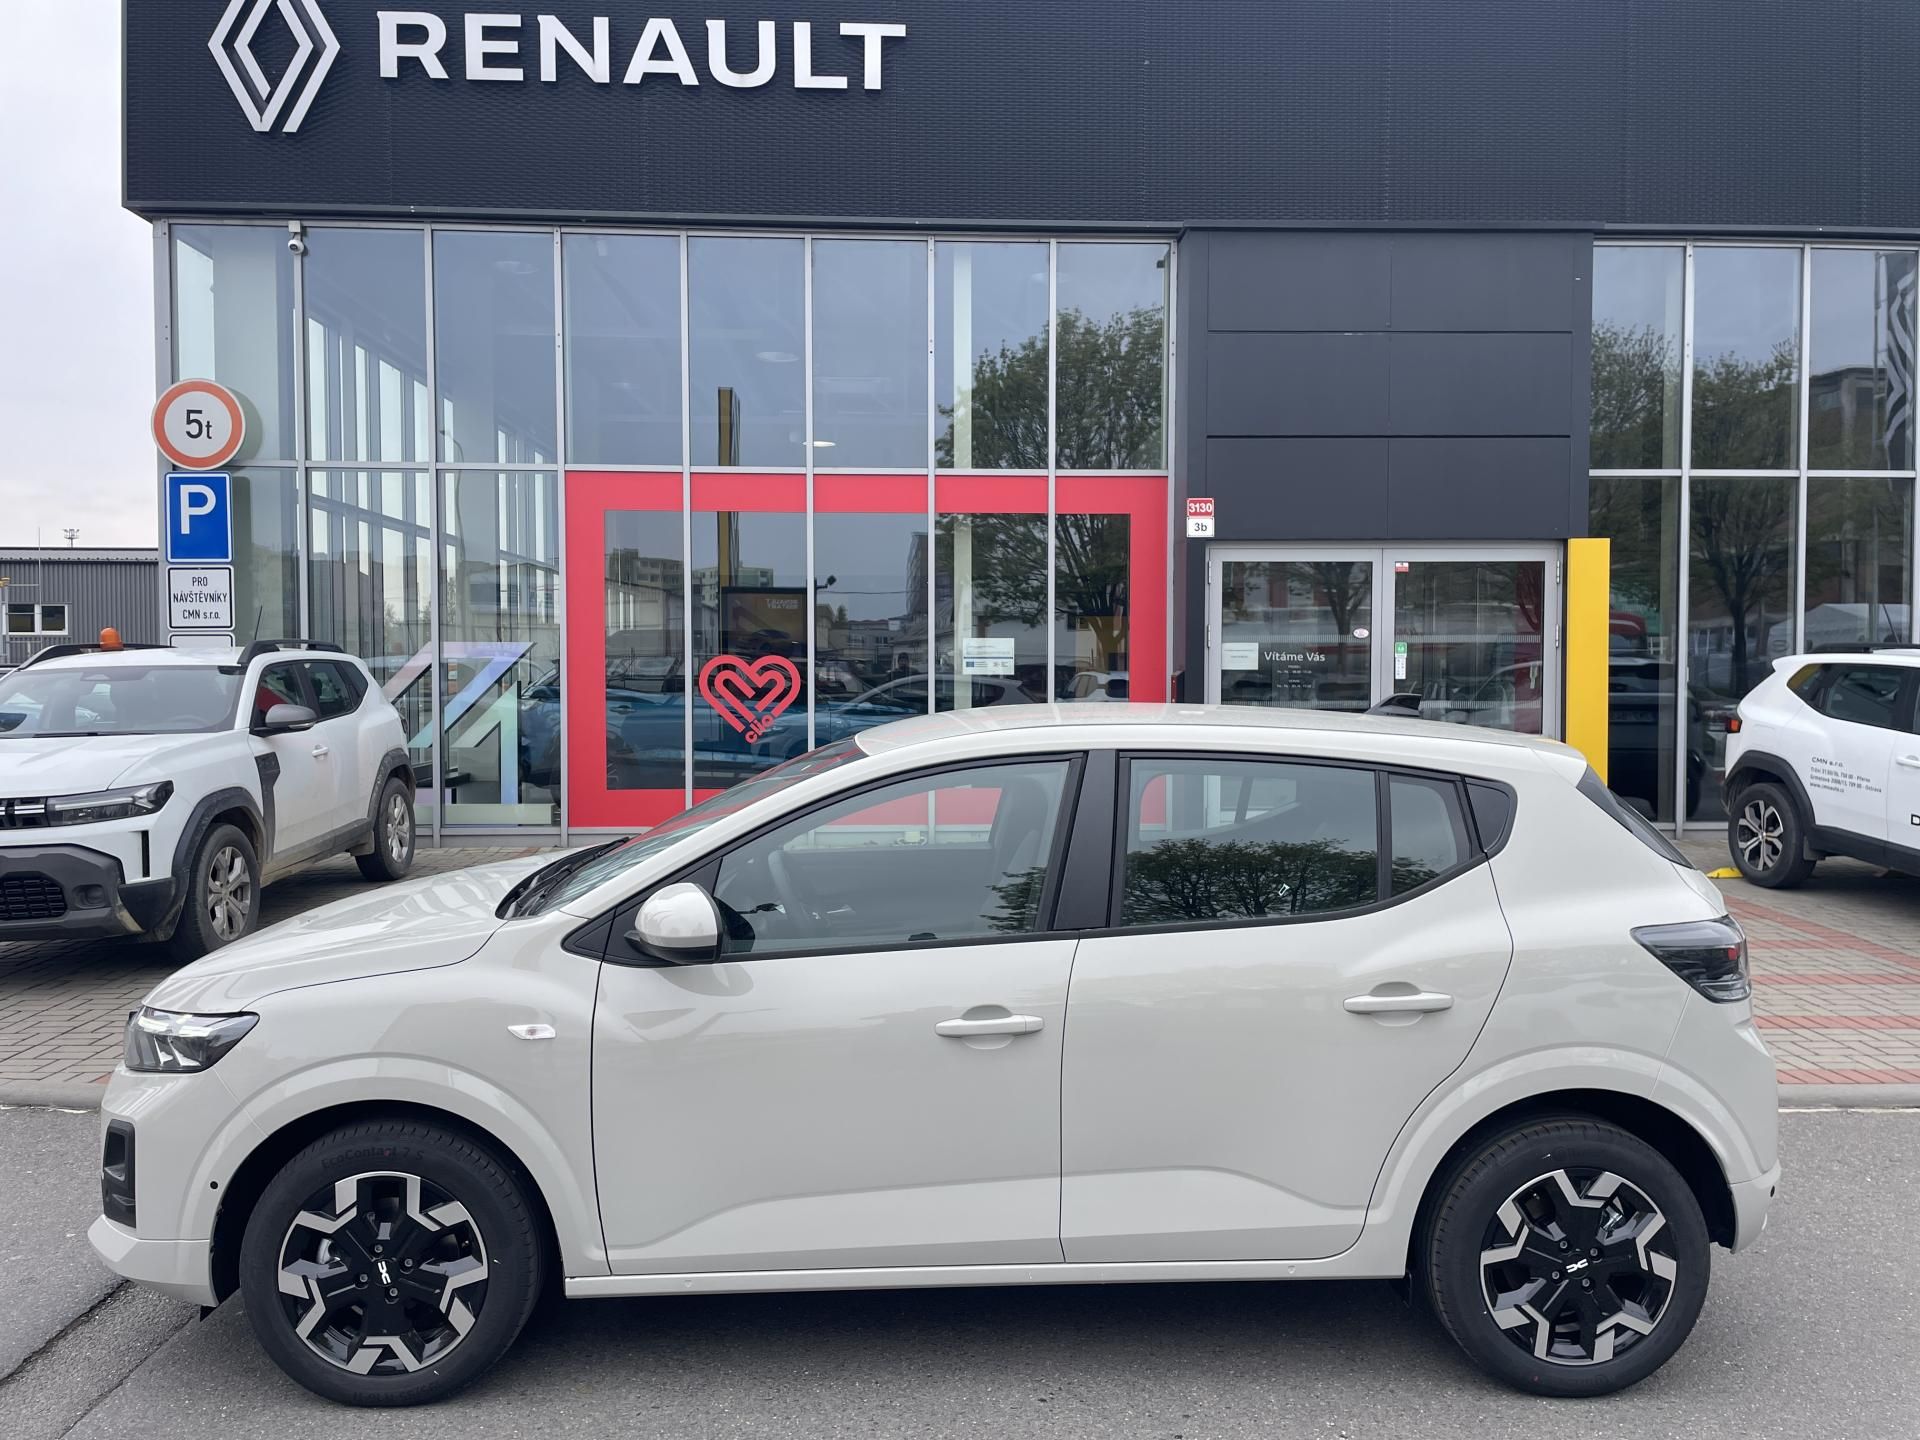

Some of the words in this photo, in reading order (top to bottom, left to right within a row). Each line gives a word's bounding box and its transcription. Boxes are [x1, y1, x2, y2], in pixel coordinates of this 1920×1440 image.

[377, 11, 906, 90] RENAULT
[180, 484, 216, 535] P
[1190, 502, 1212, 513] 3130
[1194, 522, 1208, 532] 3b
[192, 576, 208, 587] PRO
[173, 590, 228, 603] NÁVŠTĚVNÍKY
[182, 609, 201, 620] CMN
[203, 611, 221, 620] s.r.o.
[1264, 651, 1304, 662] Vítáme
[1306, 651, 1326, 662] Vás
[745, 714, 774, 744] clio
